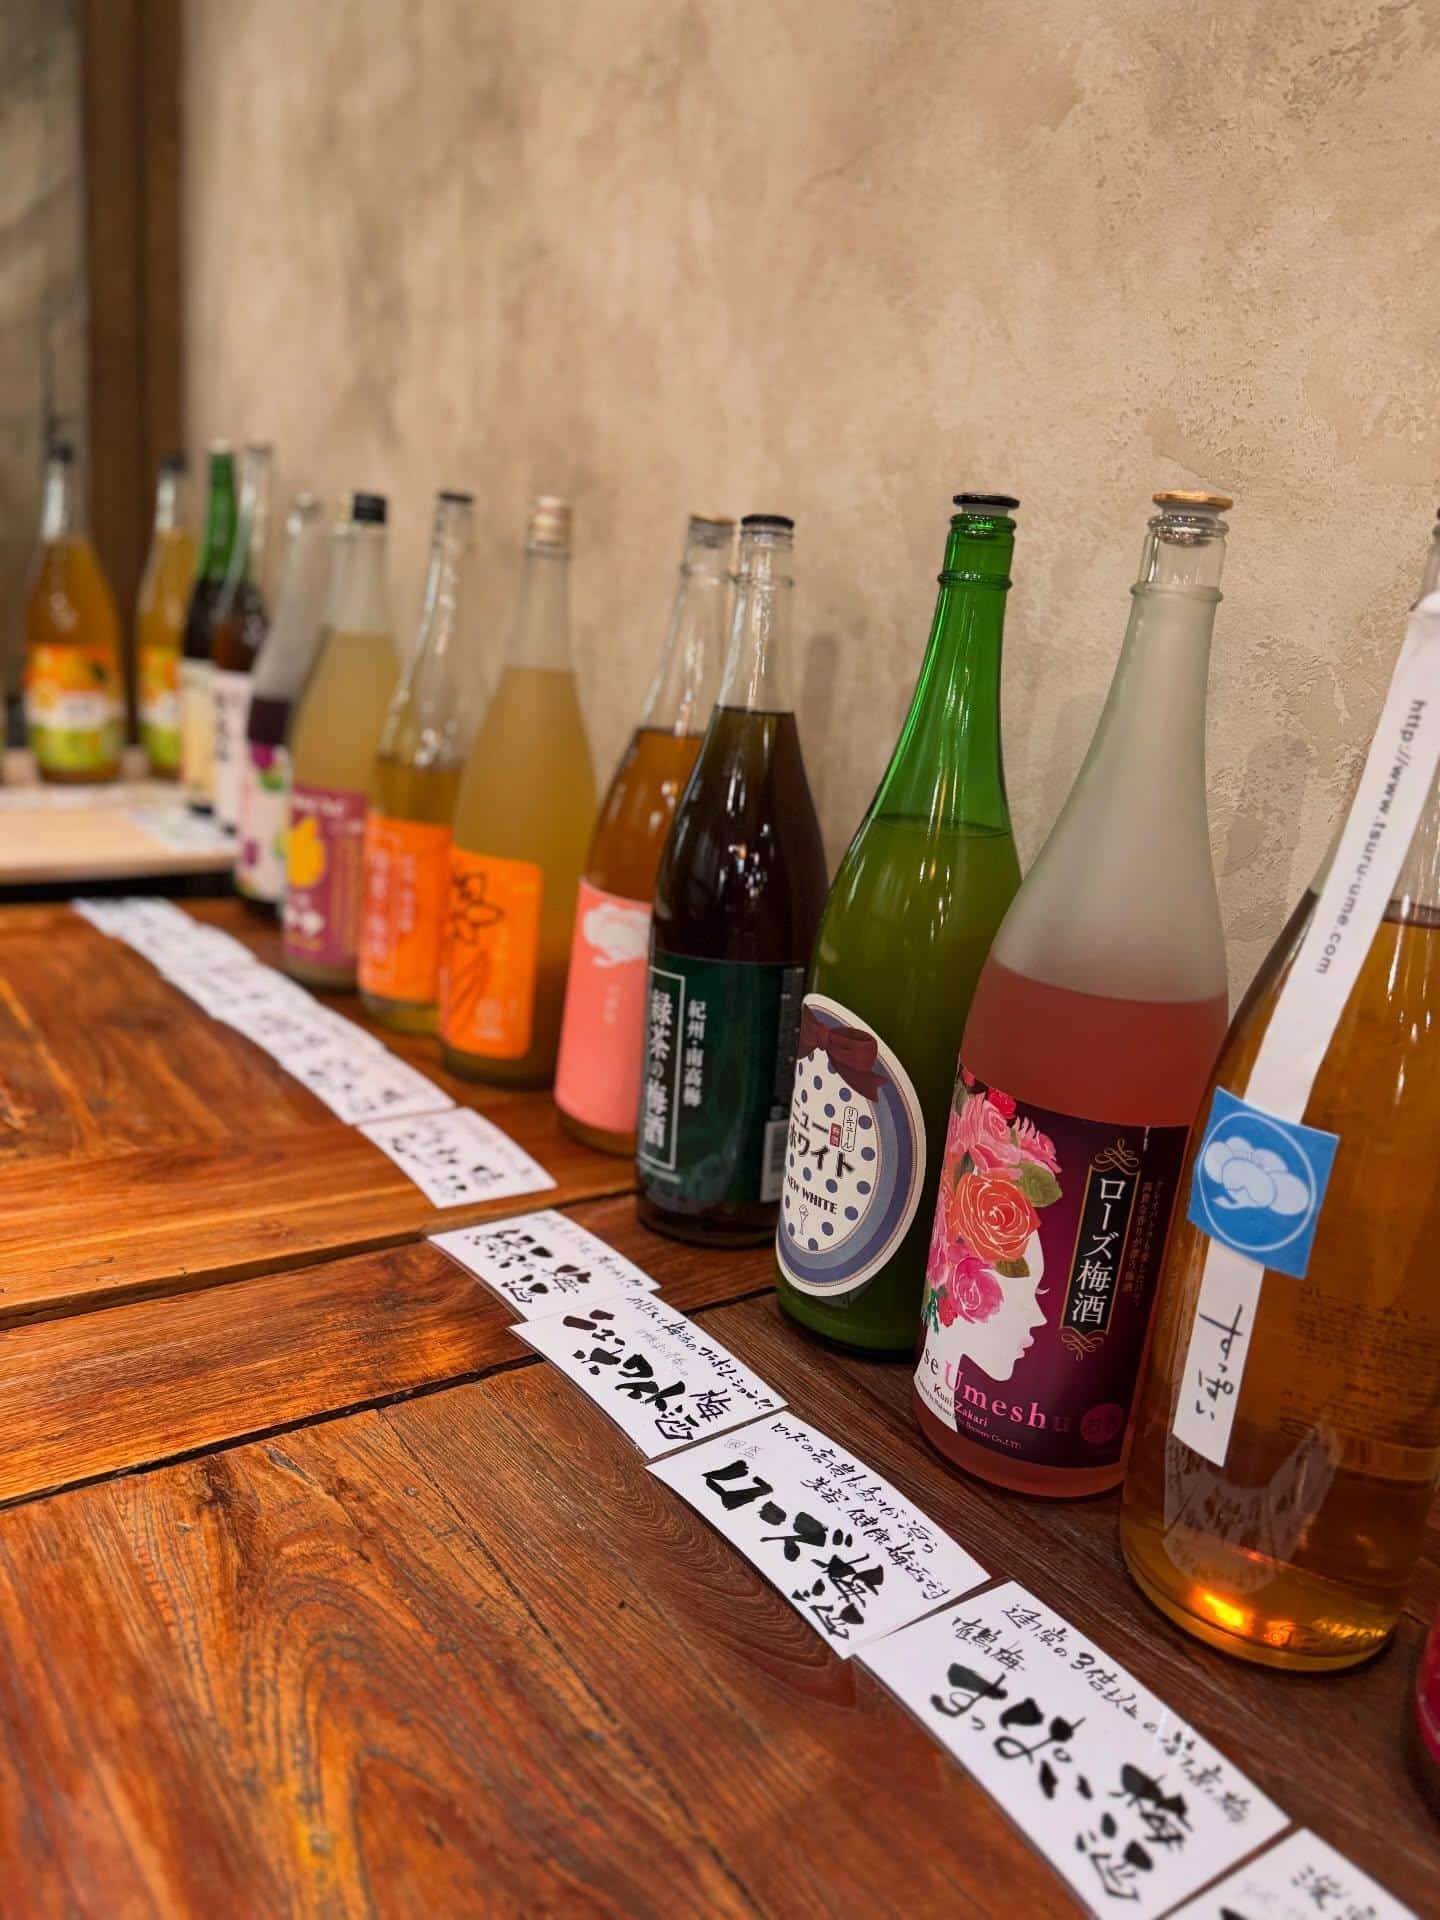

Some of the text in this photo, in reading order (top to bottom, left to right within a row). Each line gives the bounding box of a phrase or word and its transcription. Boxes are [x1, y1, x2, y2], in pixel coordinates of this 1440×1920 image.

[1315, 698, 1426, 975] http://www.tsuru-ume.com
[792, 1097, 829, 1133] ニュー
[844, 1107, 857, 1151] リキュール
[789, 1124, 856, 1178] ホワイト
[802, 1187, 839, 1215] WHITE
[1071, 1177, 1130, 1327] ローズ梅酒
[1195, 1303, 1246, 1420] すっぱい
[933, 1383, 953, 1408] Kuni
[955, 1400, 988, 1427] Zakari
[944, 1360, 1071, 1432] Umeshu
